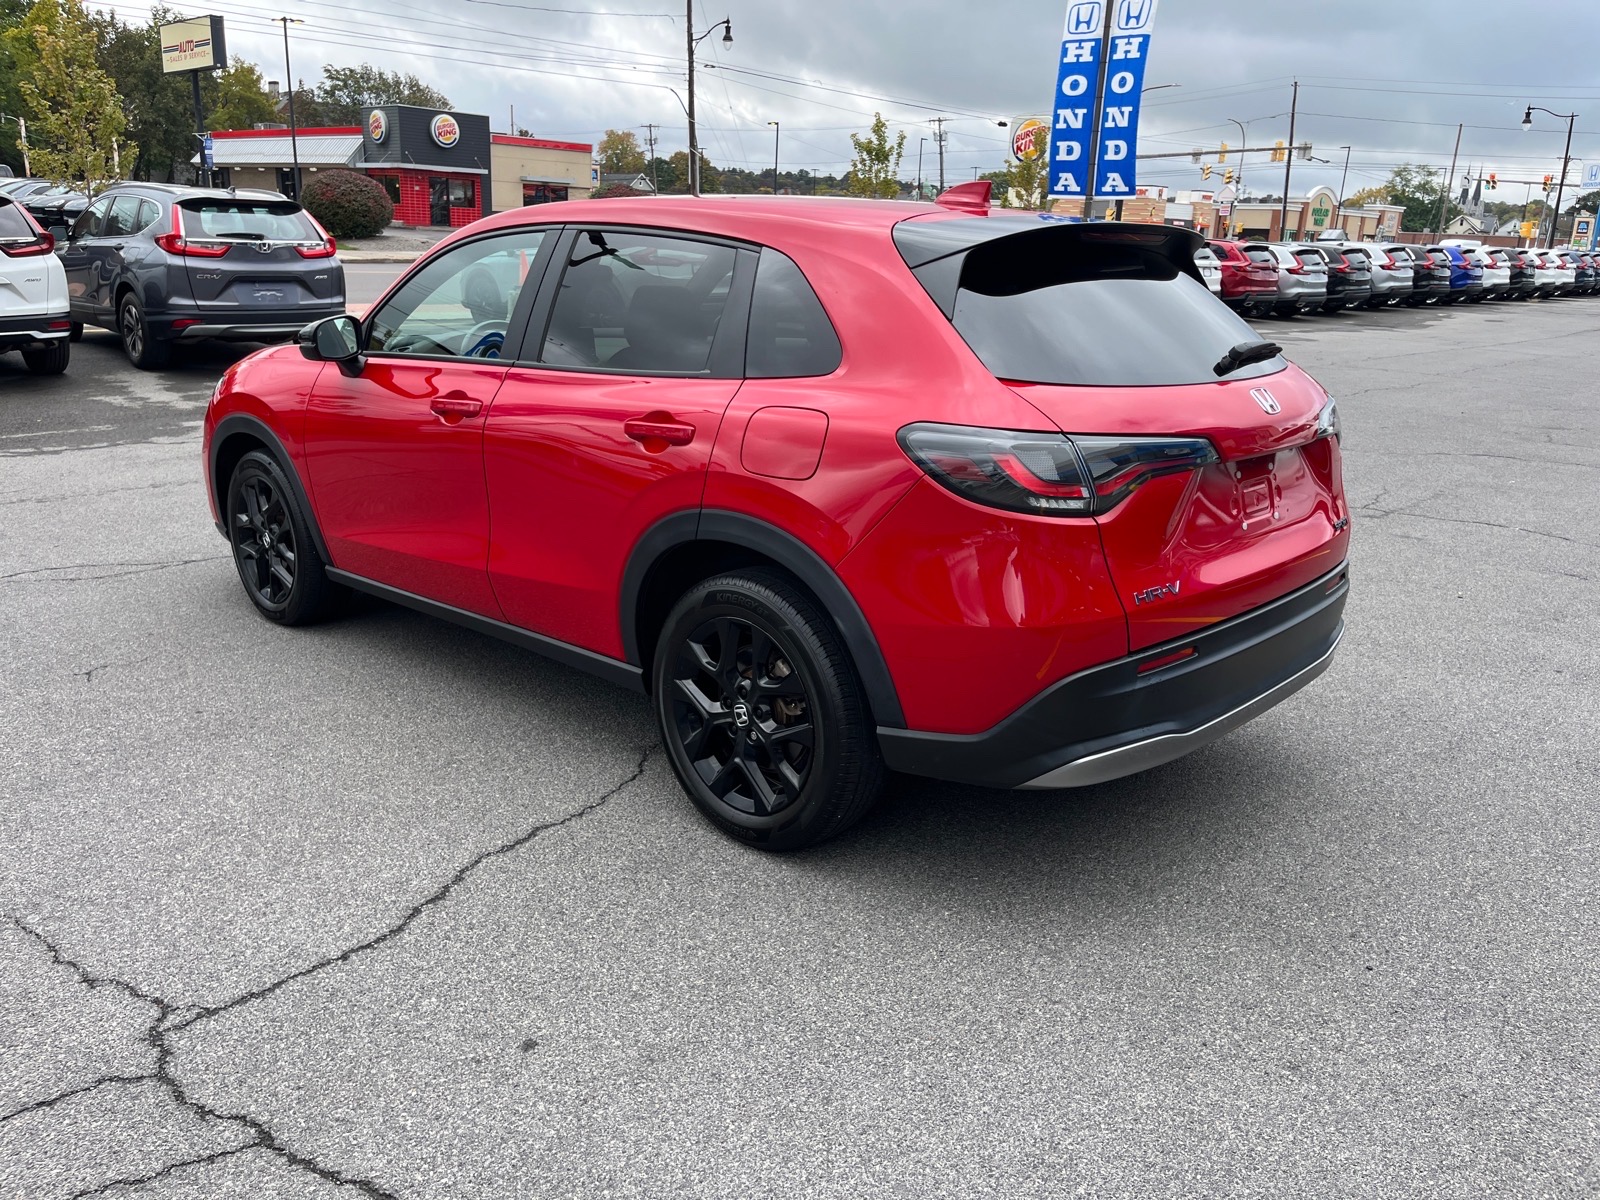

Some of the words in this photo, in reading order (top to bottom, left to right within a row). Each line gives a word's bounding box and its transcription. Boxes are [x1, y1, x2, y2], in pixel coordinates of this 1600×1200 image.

[179, 40, 195, 53] AUTO
[169, 55, 183, 63] SALES
[188, 50, 206, 60] SERVICE
[1054, 41, 1095, 192] HONDA
[1101, 37, 1143, 192] HONDA
[371, 121, 383, 135] KING
[437, 122, 456, 131] BURGER
[437, 129, 457, 139] KING
[1134, 580, 1181, 605] HR-V
[716, 592, 758, 609] KINERGY
